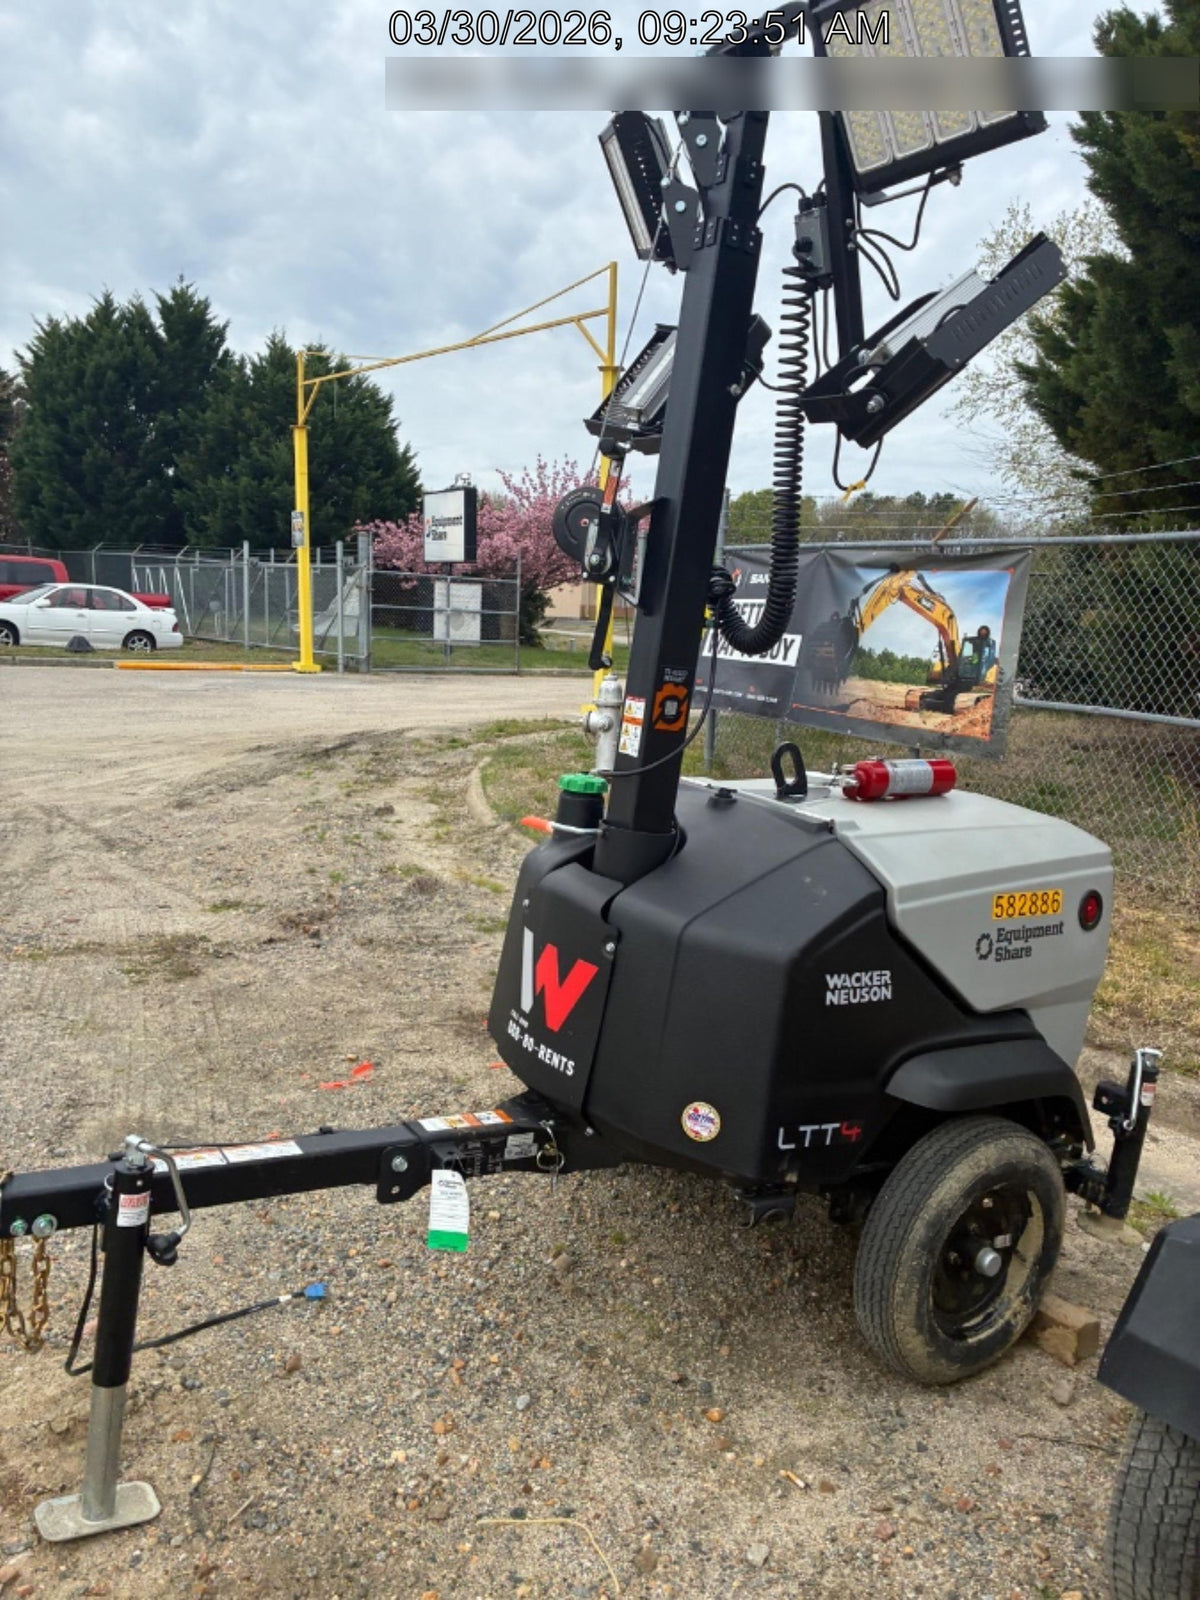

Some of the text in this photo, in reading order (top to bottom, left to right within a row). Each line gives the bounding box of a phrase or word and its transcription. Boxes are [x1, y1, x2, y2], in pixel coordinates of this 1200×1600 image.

[994, 890, 1061, 919] 582886
[996, 921, 1064, 945] Equipment
[994, 945, 1032, 962] Share
[825, 970, 892, 989] WACKER
[825, 985, 892, 1006] NEUSON
[777, 1121, 861, 1150] LTT4
